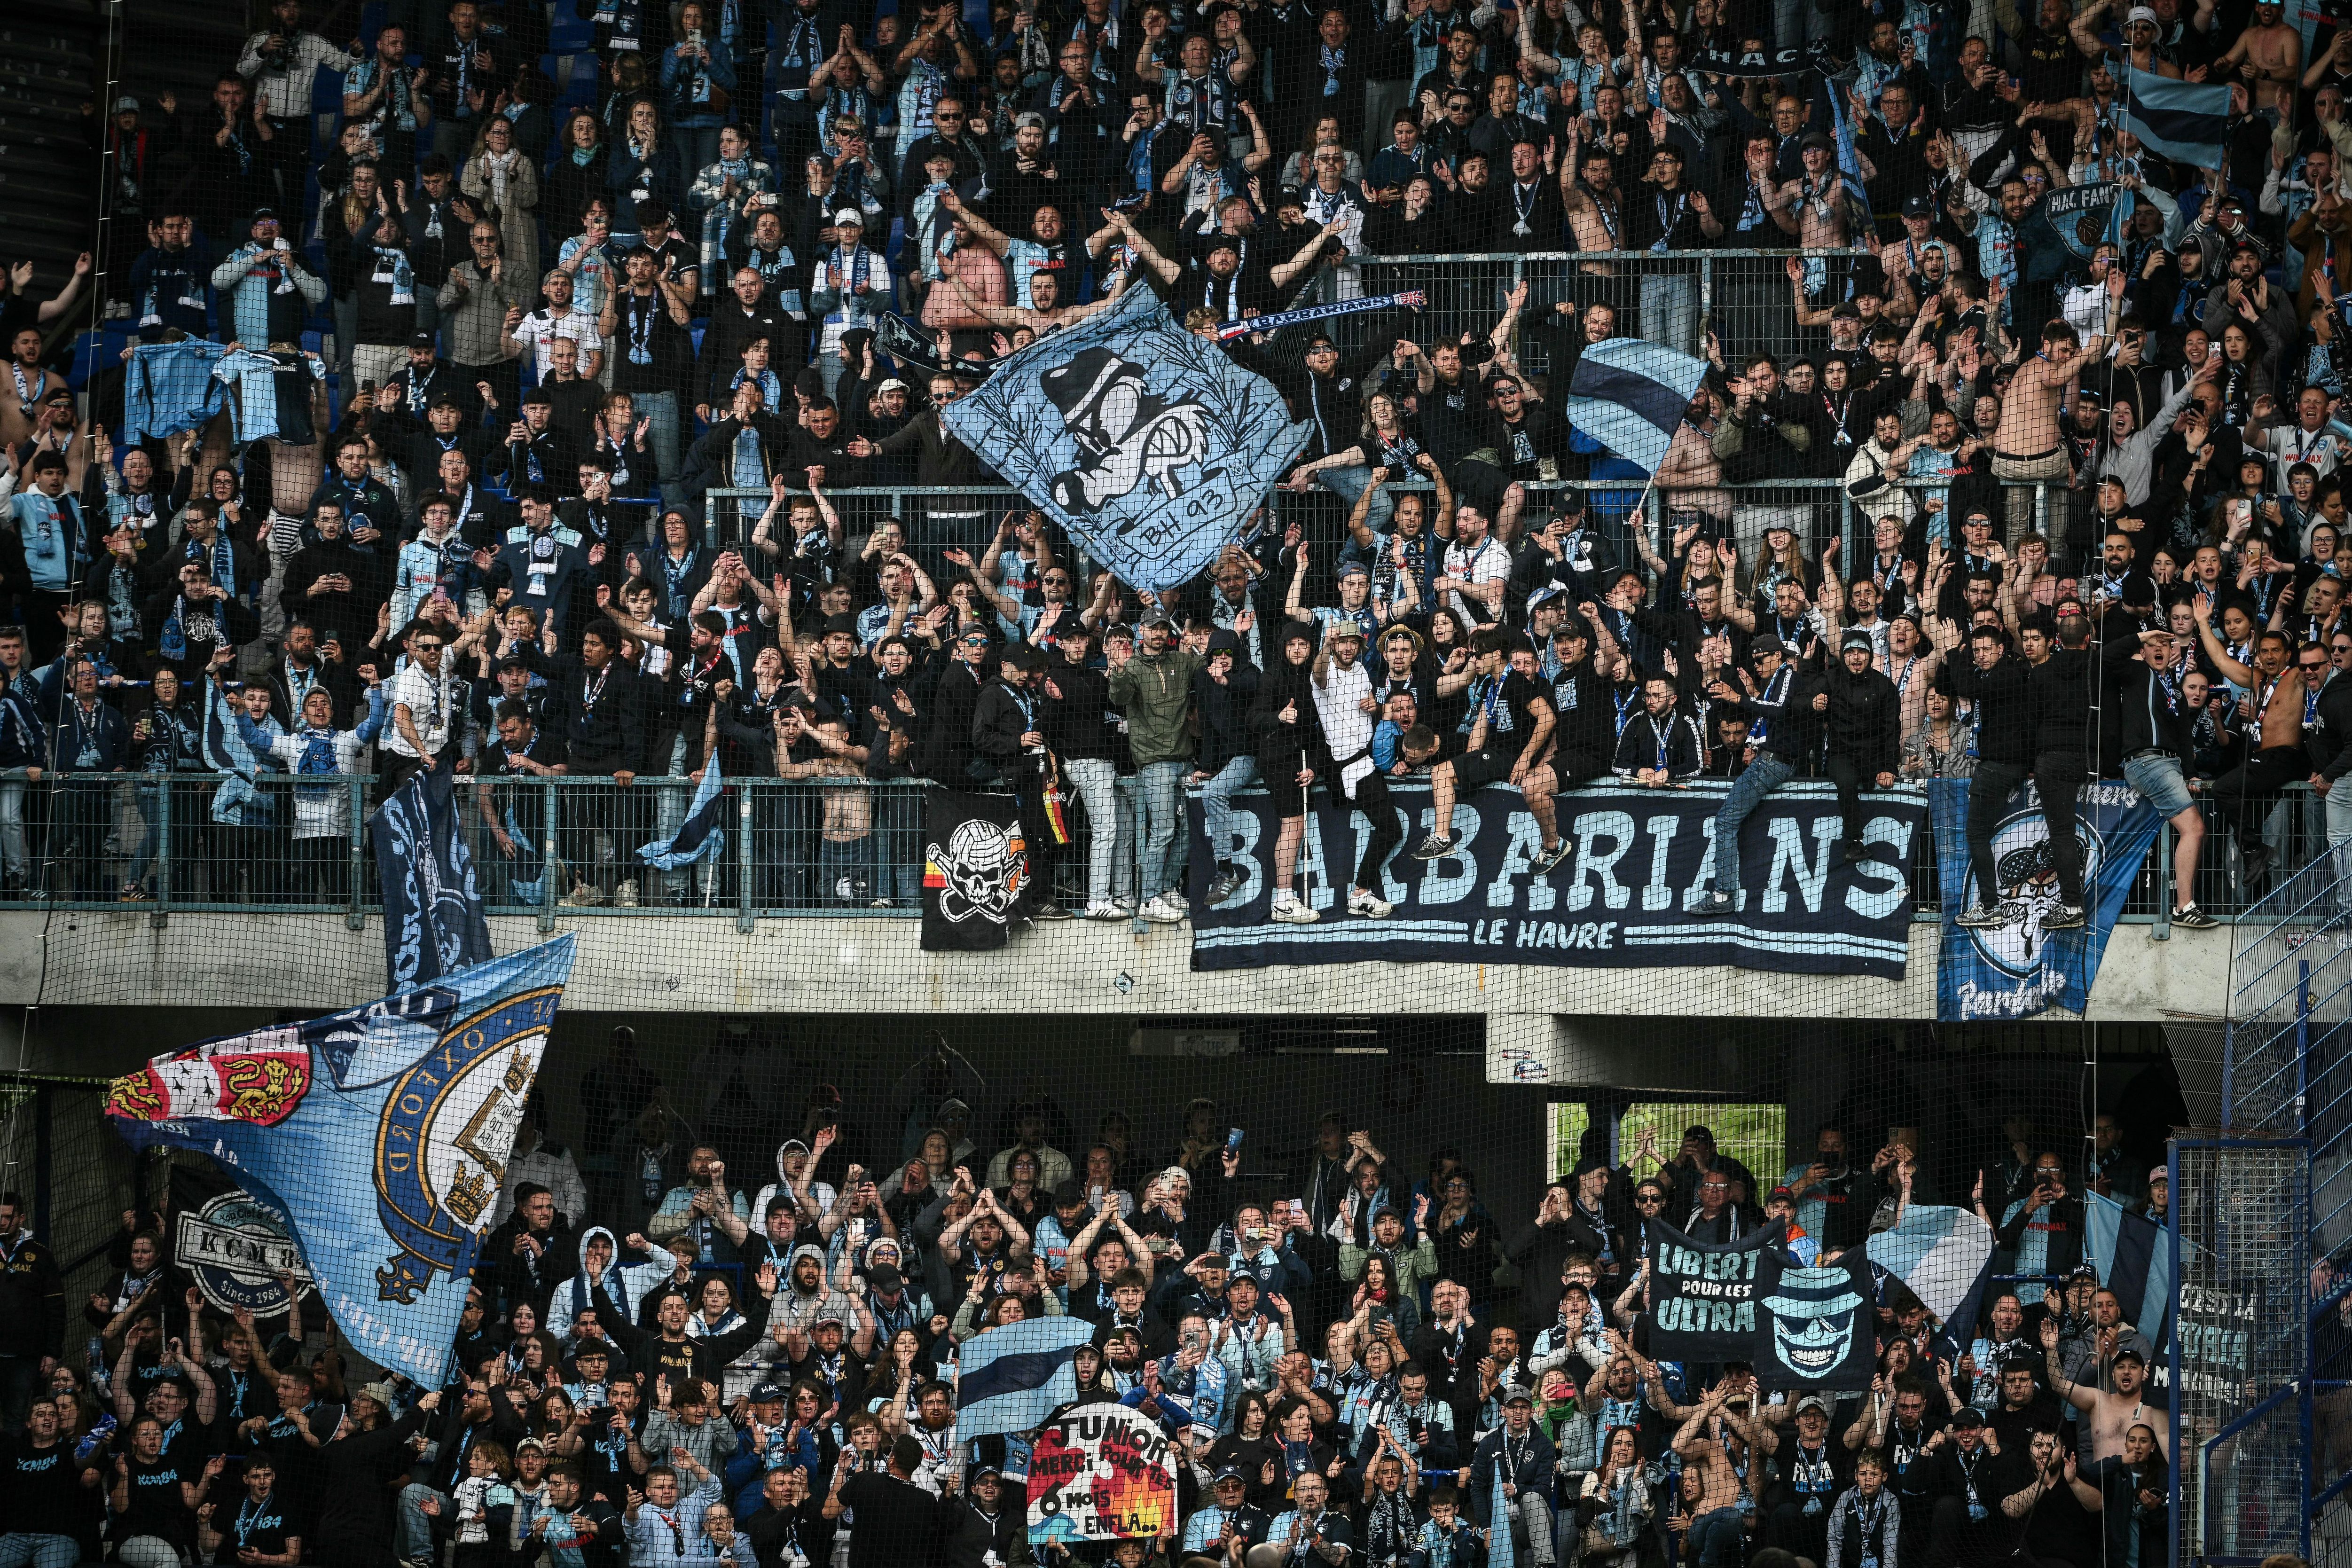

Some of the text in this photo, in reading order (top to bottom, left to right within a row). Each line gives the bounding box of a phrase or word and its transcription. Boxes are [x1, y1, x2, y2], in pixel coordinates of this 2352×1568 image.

[1709, 49, 1798, 66] HAC
[2051, 189, 2077, 212] HAC
[1028, 257, 1066, 269] WINAMAX
[1261, 297, 1390, 328] BARBARIANS
[2285, 454, 2322, 463] WINMAX
[1937, 465, 1973, 476] WINAMAX
[1006, 579, 1038, 590] WINAMAX
[1375, 575, 1390, 584] HAC
[1474, 918, 1617, 949] LE HAVRE
[1806, 1192, 1847, 1203] WINAMAX
[2028, 1222, 2066, 1231] WINAMAX
[200, 1231, 267, 1264] KCM
[1658, 1241, 1768, 1281] LIBERT
[221, 1280, 251, 1303] Since
[1682, 1279, 1753, 1297] POUR LES
[1658, 1297, 1756, 1333] ULTRA
[770, 1443, 785, 1453] HAC
[1100, 1444, 1147, 1478] POUR
[1150, 1464, 1175, 1490] TES
[1039, 1481, 1064, 1516] 6
[557, 1532, 595, 1550] WINAMAX
